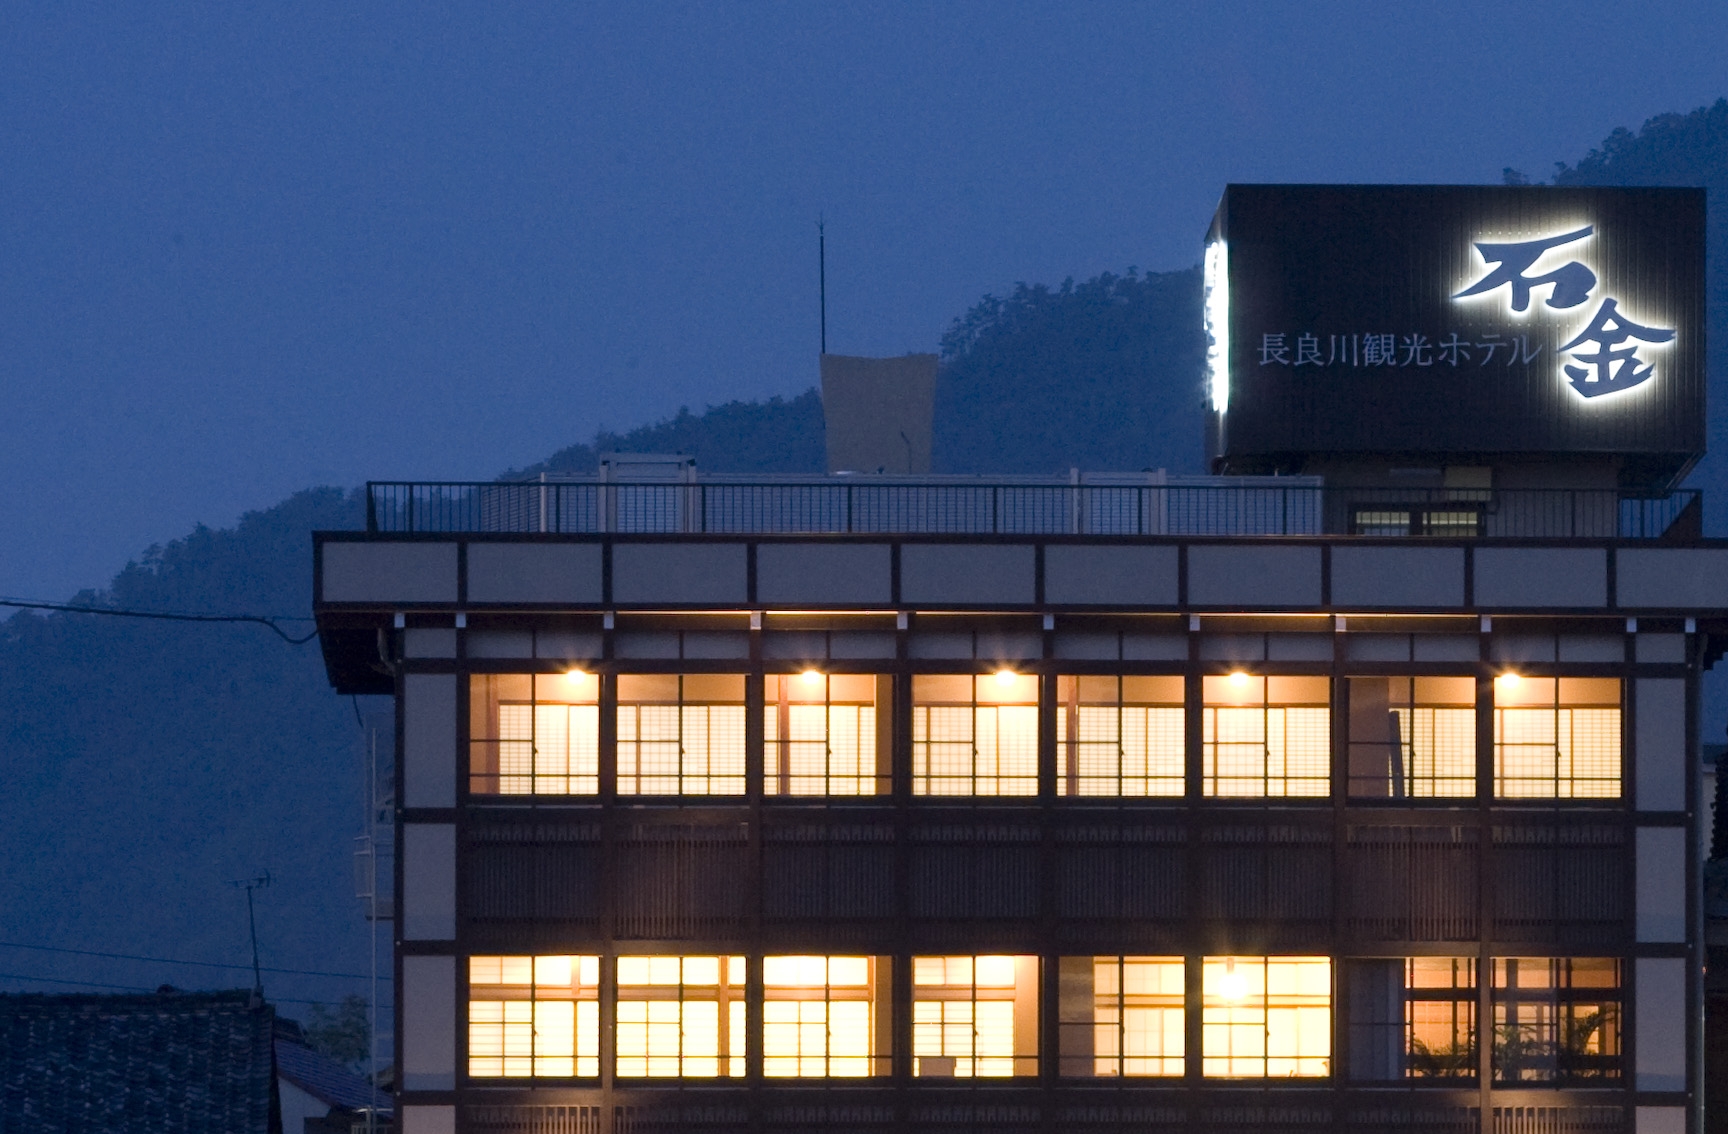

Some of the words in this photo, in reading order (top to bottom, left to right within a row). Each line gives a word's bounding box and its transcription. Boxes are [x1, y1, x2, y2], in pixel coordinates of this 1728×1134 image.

[1257, 332, 1543, 367] 長良川観光ホテル
[1451, 224, 1678, 399] 石金
